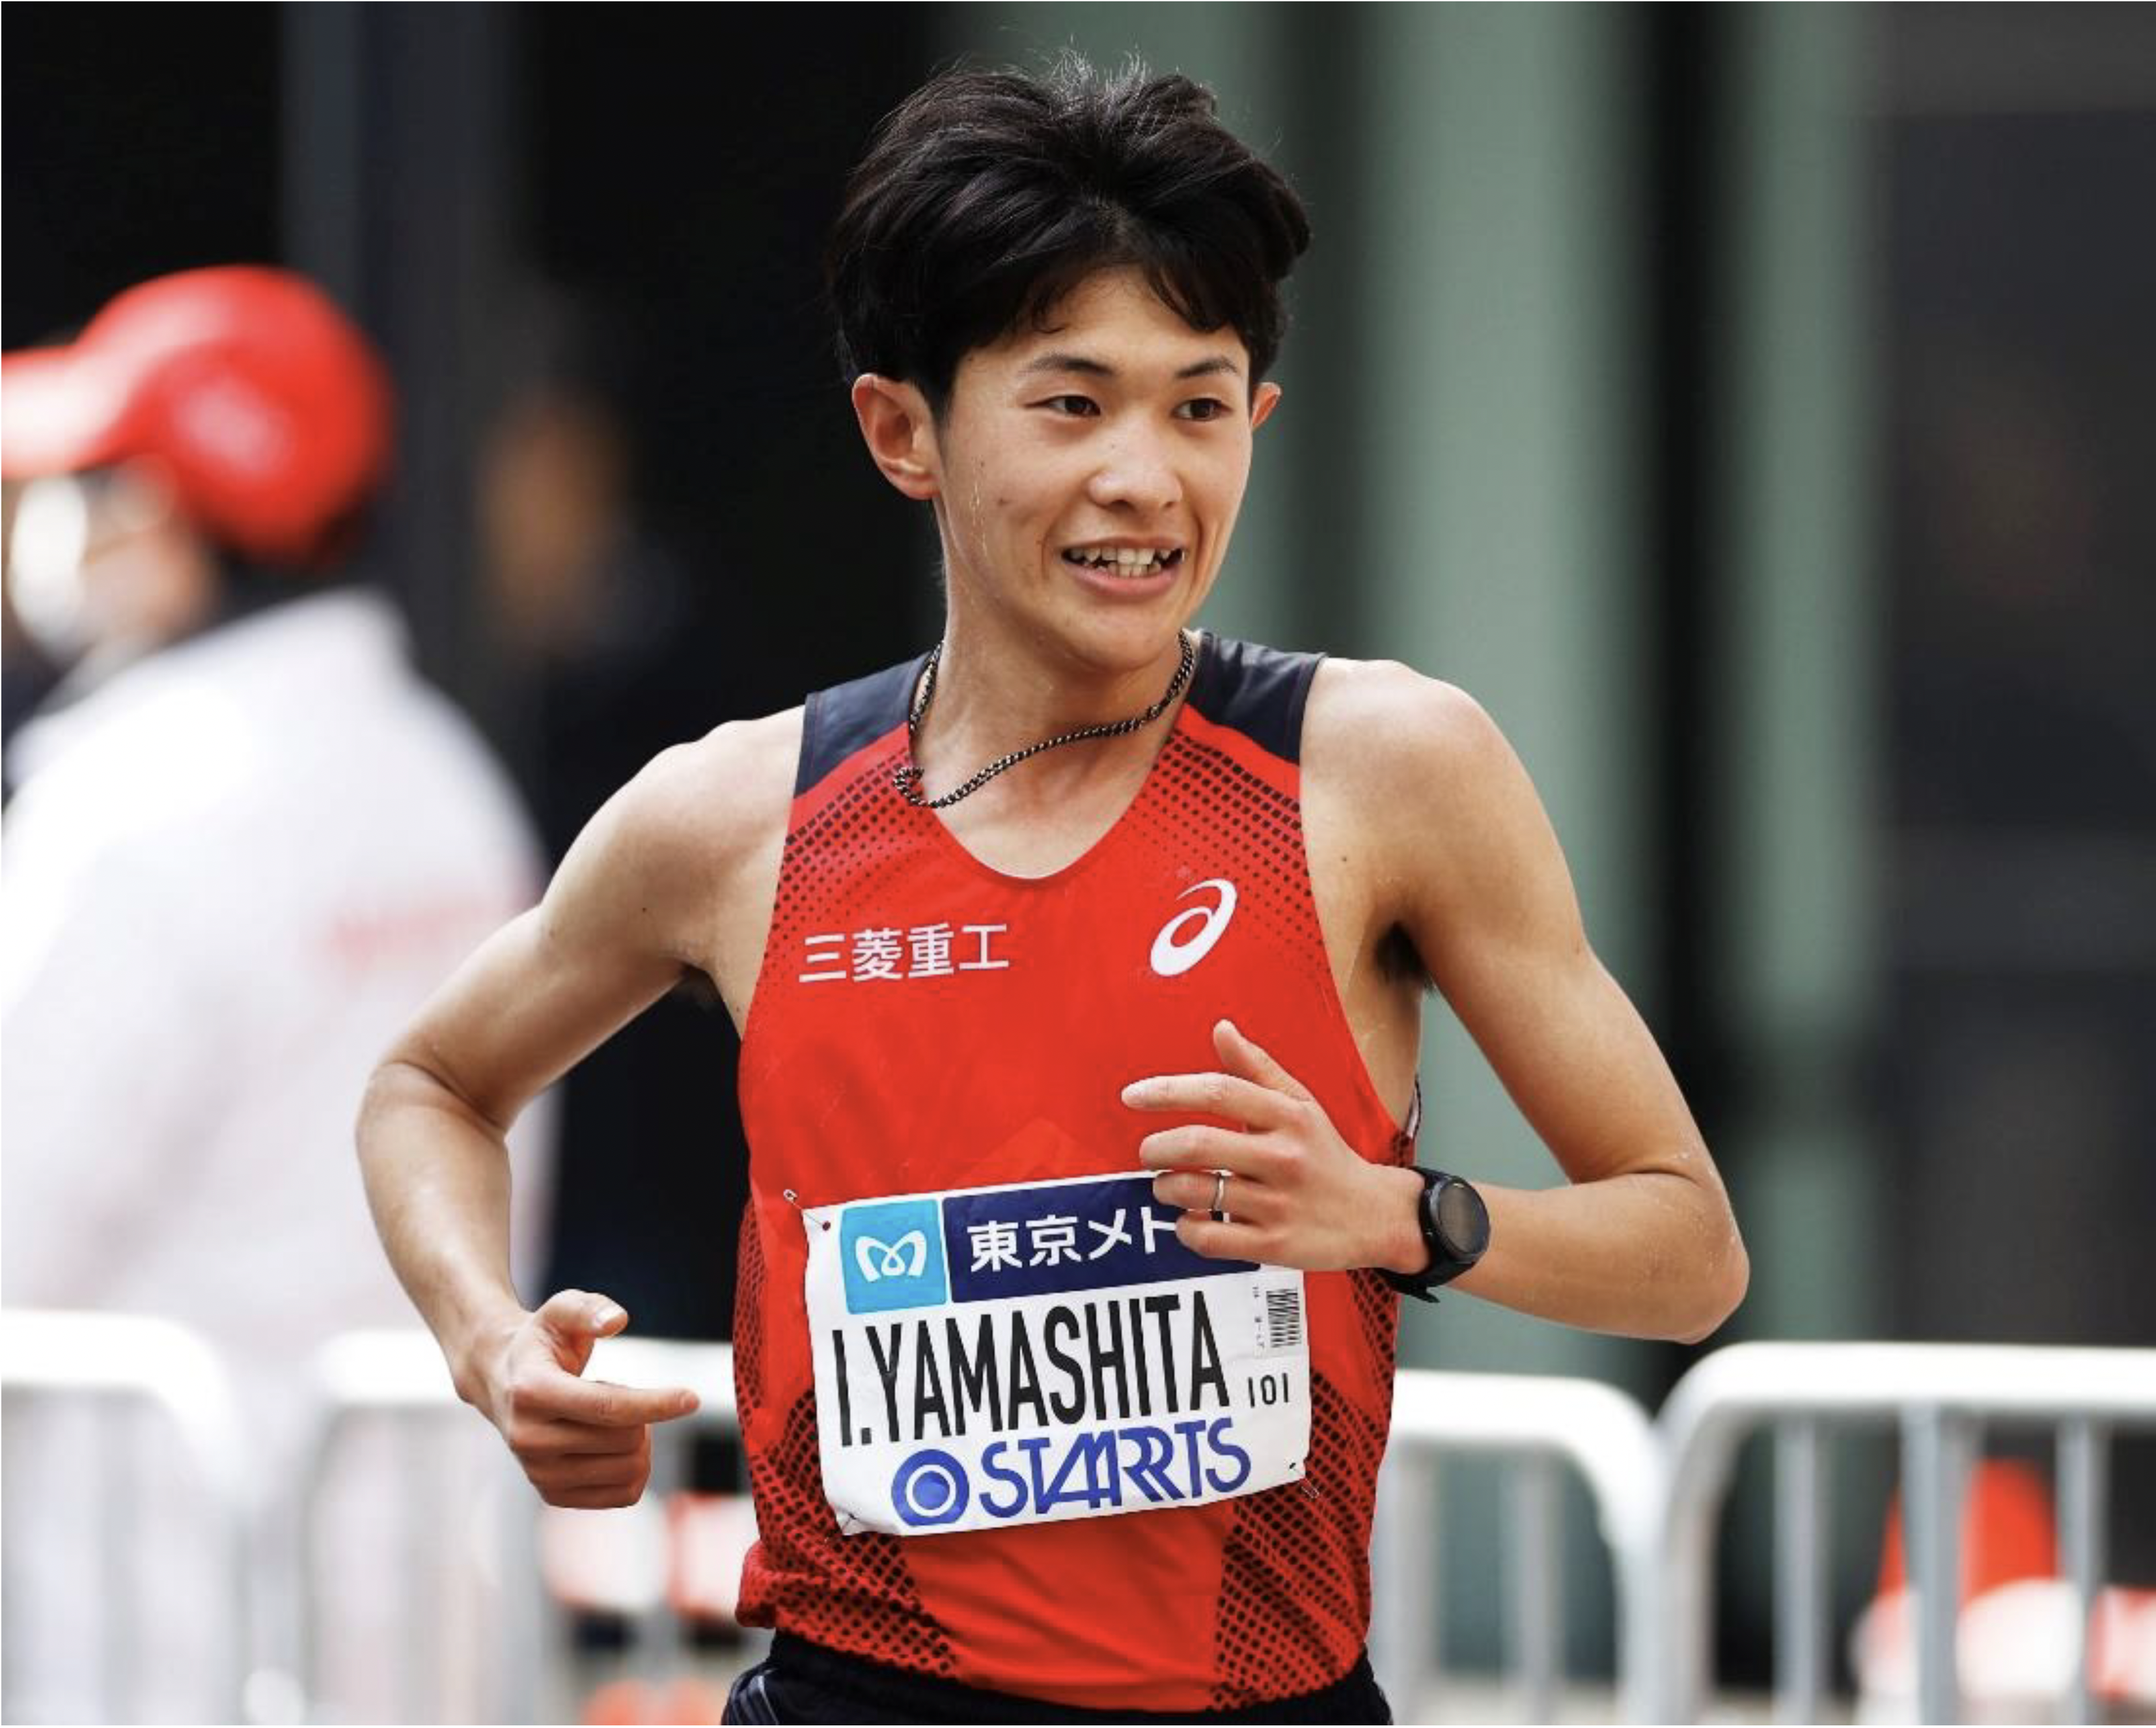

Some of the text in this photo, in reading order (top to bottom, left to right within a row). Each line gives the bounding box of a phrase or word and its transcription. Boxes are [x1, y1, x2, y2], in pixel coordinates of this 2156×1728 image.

[799, 923, 1010, 982] 三菱重工
[967, 1206, 1230, 1272] 東京メト
[832, 1290, 1230, 1447] I.YAMASHITA
[1248, 1372, 1289, 1408] 101
